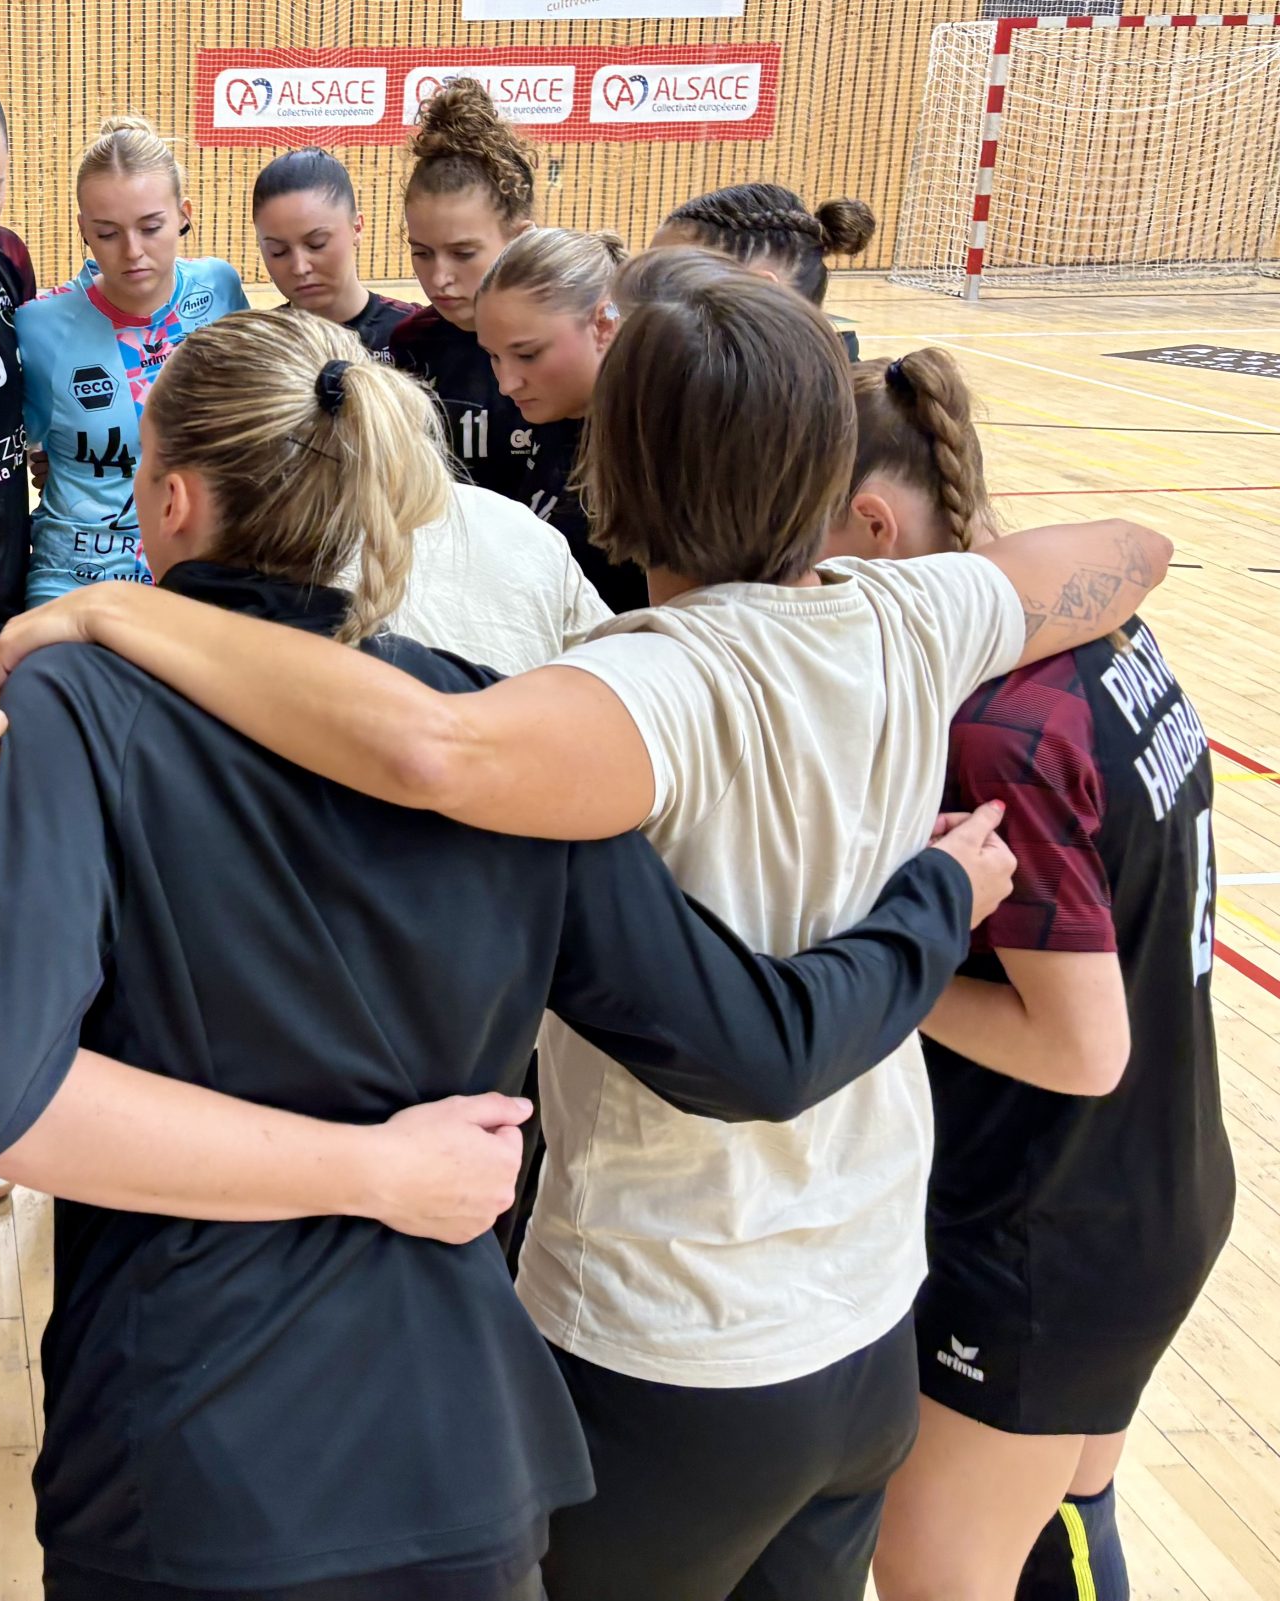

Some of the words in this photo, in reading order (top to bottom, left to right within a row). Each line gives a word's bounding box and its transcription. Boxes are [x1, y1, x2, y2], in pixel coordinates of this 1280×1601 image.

[277, 80, 375, 105] ALSACE
[484, 78, 564, 103] LSACE
[654, 76, 750, 101] ALSACE
[182, 295, 209, 313] Anita
[140, 353, 170, 368] erim
[74, 380, 114, 397] reca
[460, 409, 489, 458] 11
[75, 426, 136, 478] 44
[74, 531, 136, 554] EUR
[937, 1350, 984, 1382] erima
